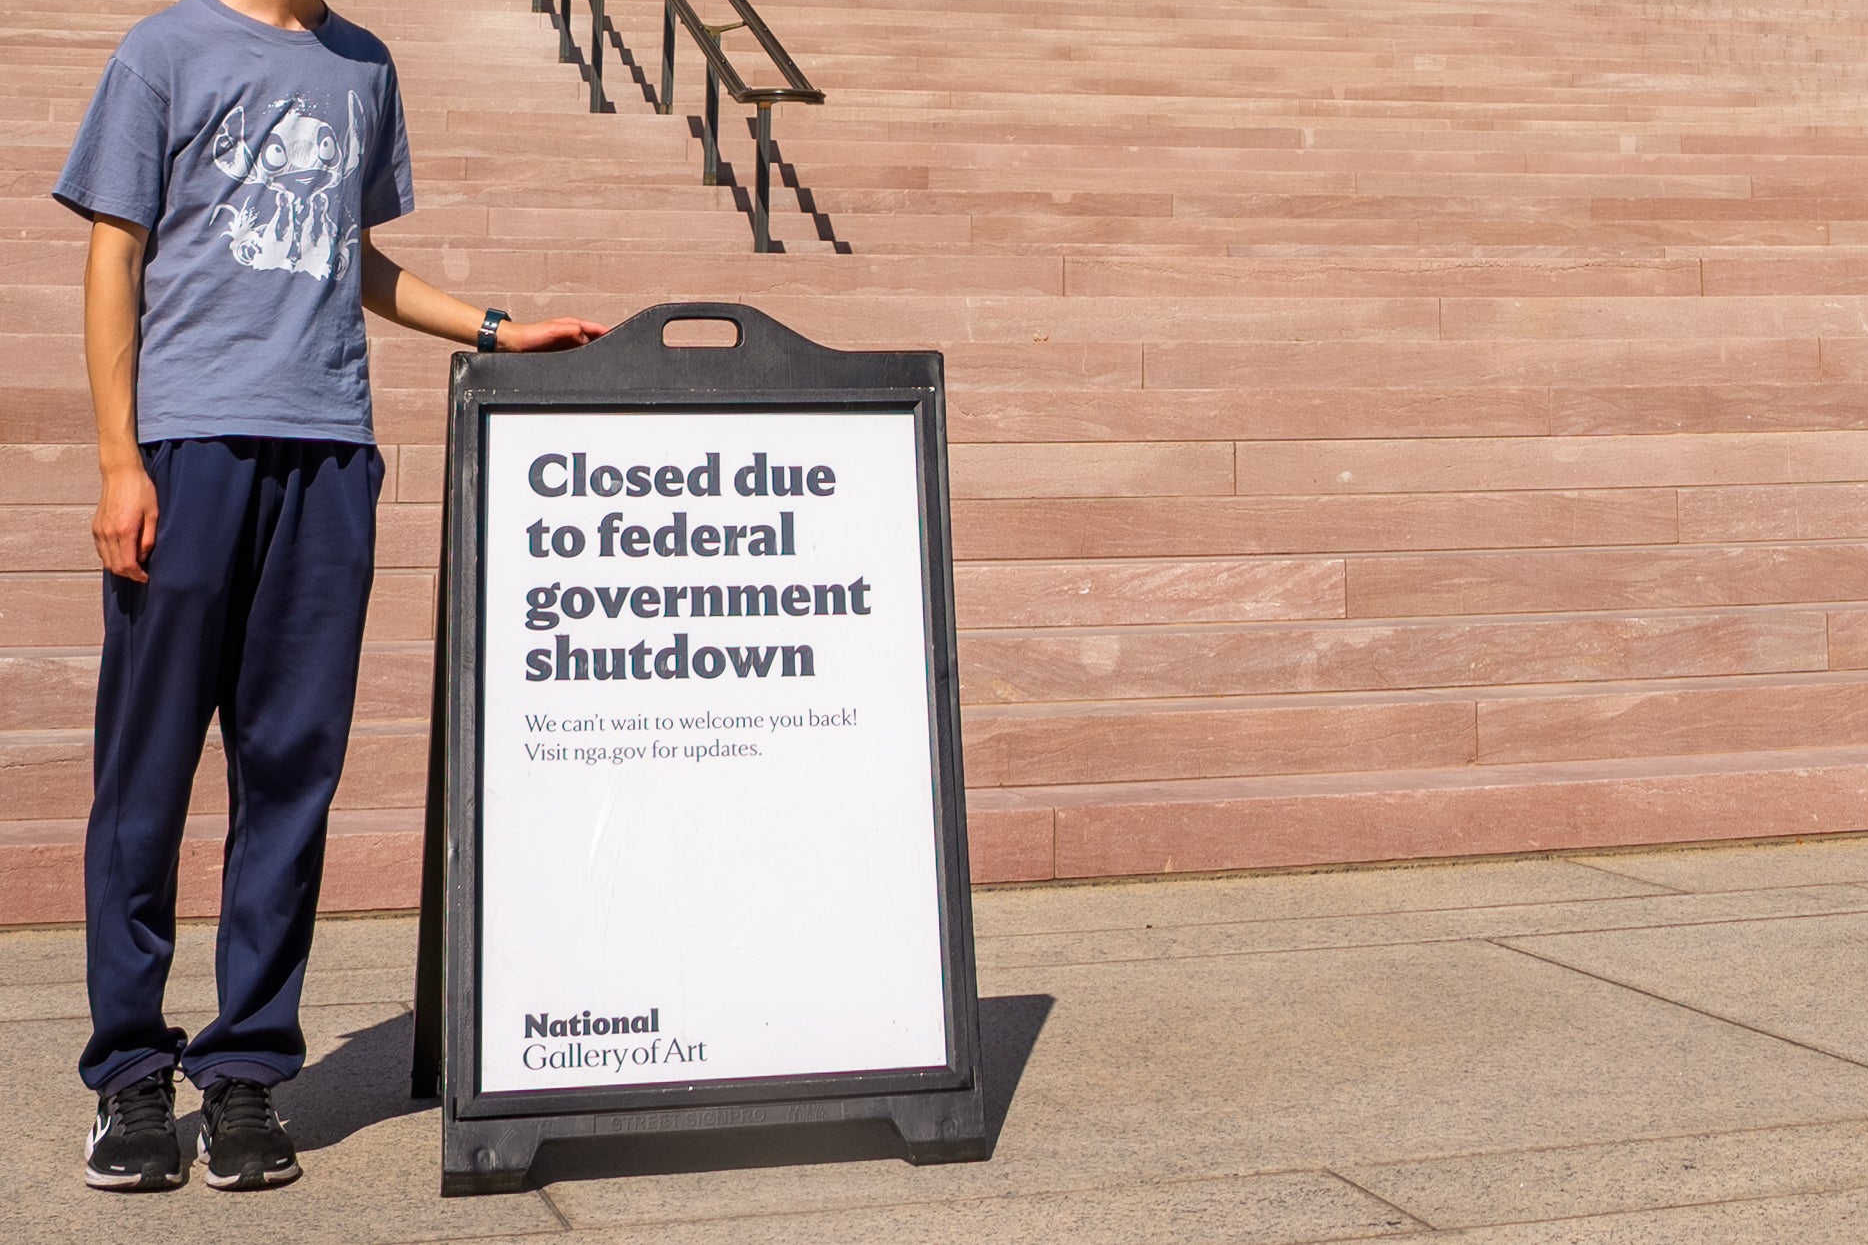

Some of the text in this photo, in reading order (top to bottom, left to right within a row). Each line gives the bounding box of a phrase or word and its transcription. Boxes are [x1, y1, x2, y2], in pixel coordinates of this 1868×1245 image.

[528, 453, 837, 498] Closed due
[525, 511, 796, 559] to federal
[524, 576, 872, 631] government
[525, 633, 816, 682] shutdown
[524, 714, 557, 733] We
[610, 713, 649, 731] wait
[655, 716, 674, 731] to
[679, 710, 764, 730] welcome
[769, 715, 803, 733] you
[808, 707, 858, 727] back!
[524, 738, 763, 766] Visit nga.gov for updates.
[524, 1007, 660, 1039] National
[522, 1038, 708, 1073] Gallery of Art
[611, 1112, 679, 1132] STREET
